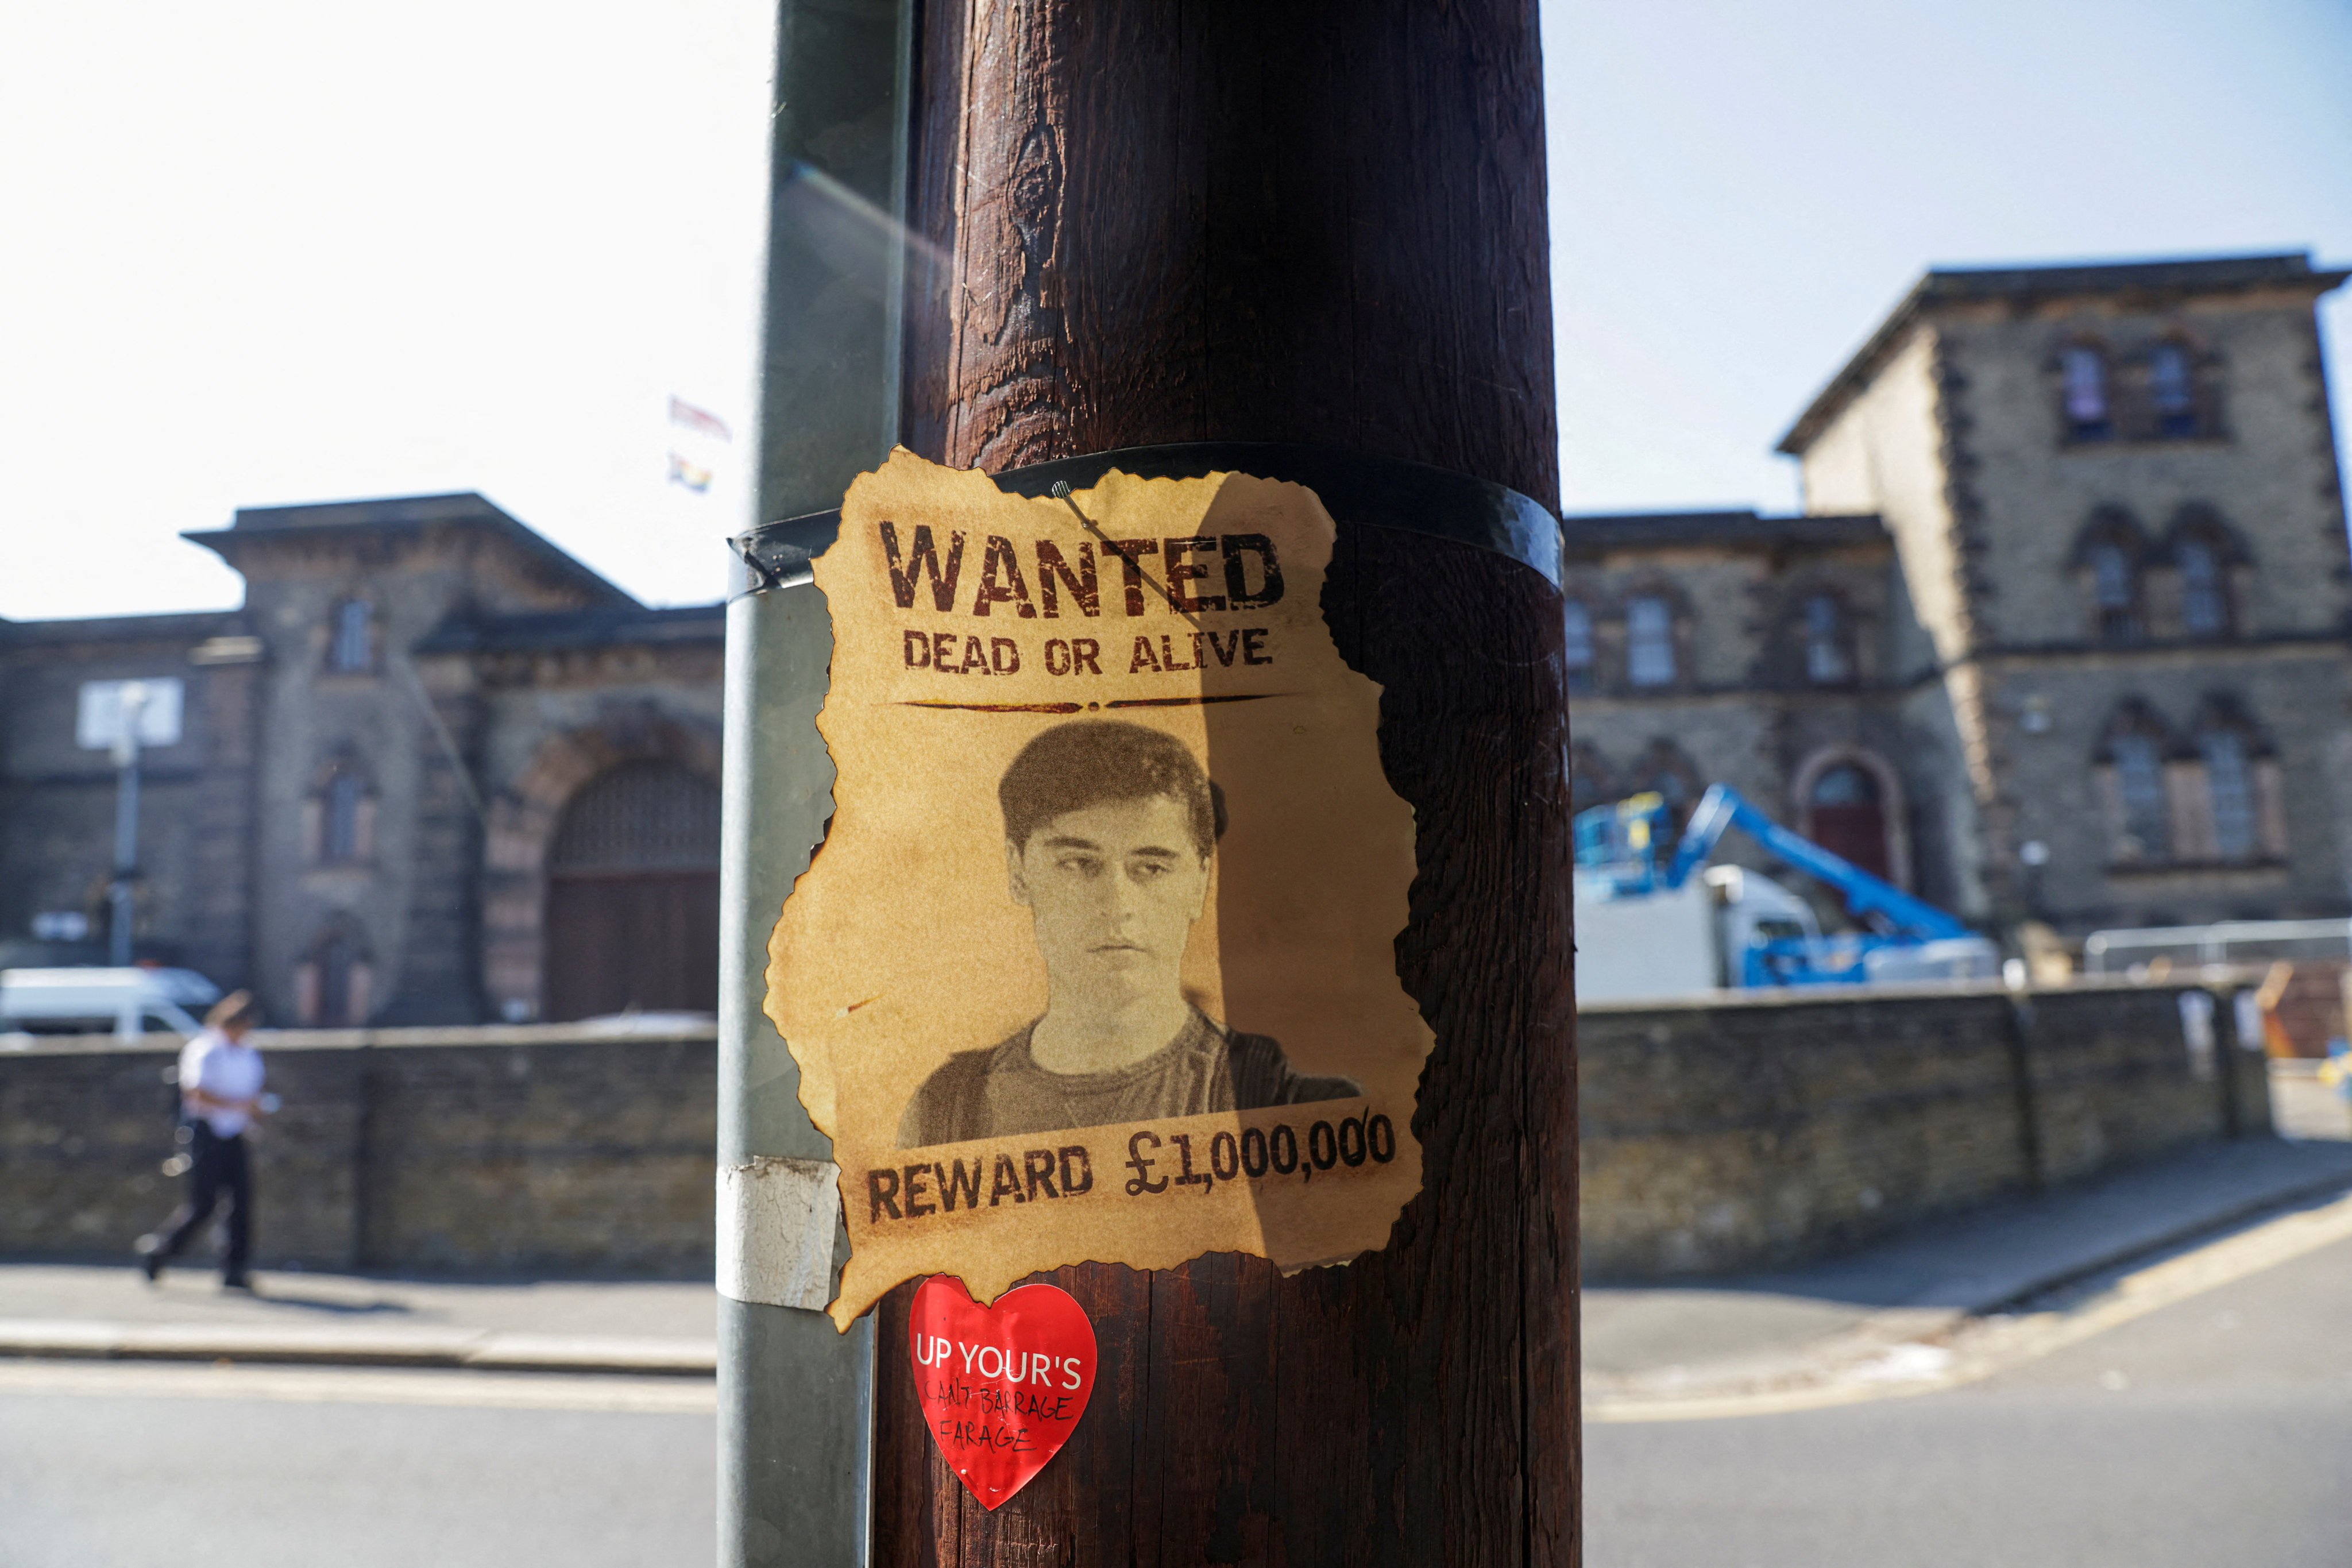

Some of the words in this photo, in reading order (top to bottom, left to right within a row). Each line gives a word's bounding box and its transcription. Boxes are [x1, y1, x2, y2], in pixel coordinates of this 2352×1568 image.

[879, 520, 1285, 619] WANTED
[903, 629, 1021, 676] DEAD
[1044, 638, 1103, 676] OR
[1129, 628, 1273, 674] ALIVE
[867, 1145, 1094, 1224] REWARD
[1124, 1109, 1397, 1196] £1,000,000
[917, 1333, 952, 1368] UP
[959, 1342, 1081, 1389] YOUR'S
[980, 1388, 1074, 1421] BARRAGE
[940, 1420, 1037, 1454] FARAGE
